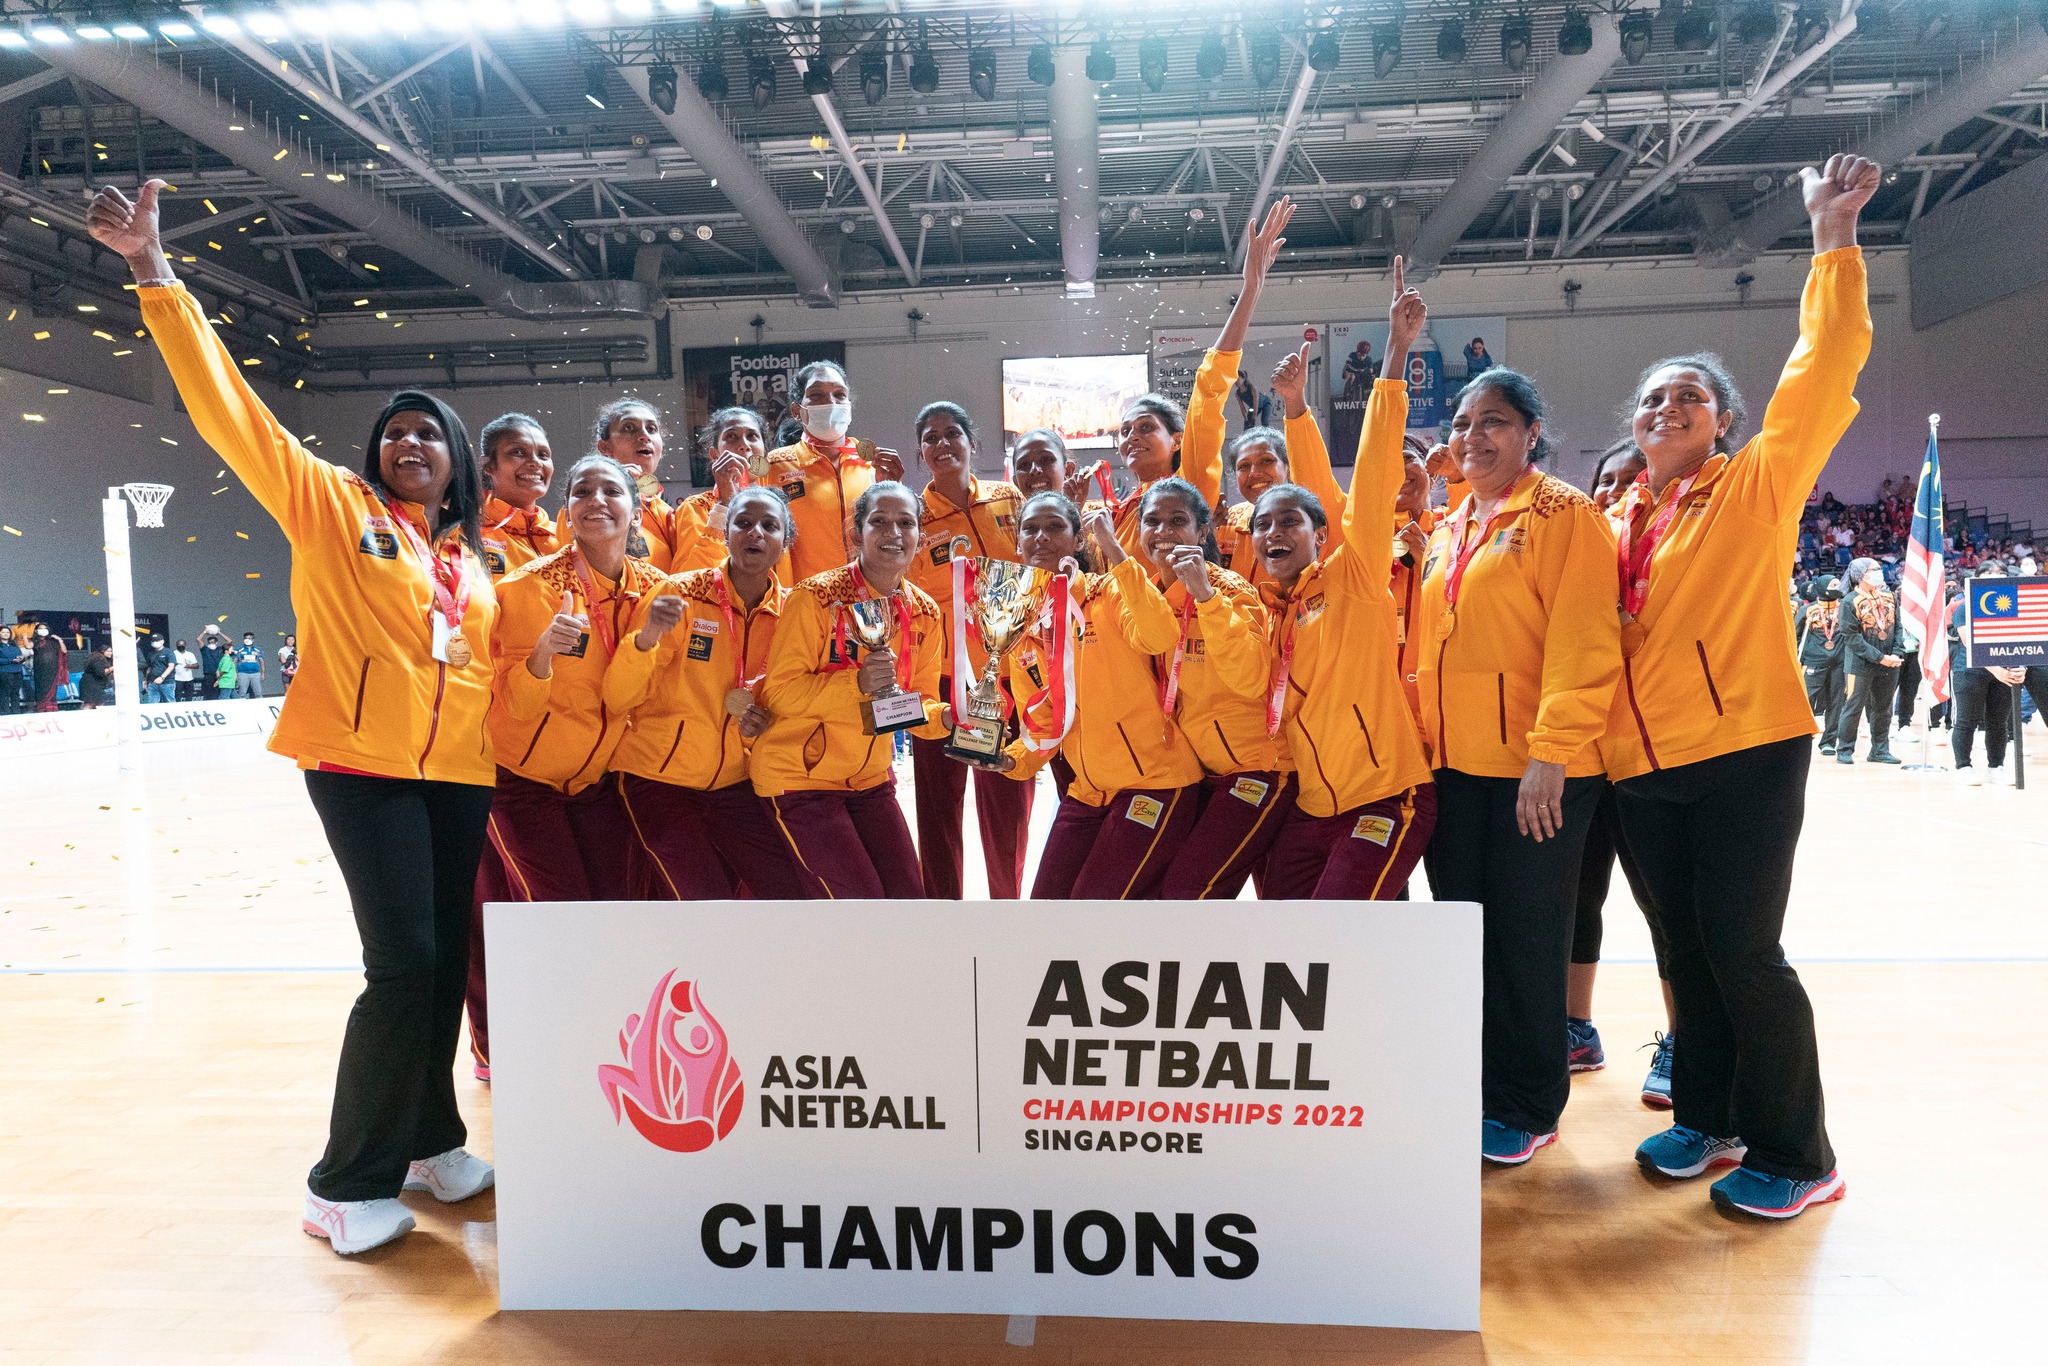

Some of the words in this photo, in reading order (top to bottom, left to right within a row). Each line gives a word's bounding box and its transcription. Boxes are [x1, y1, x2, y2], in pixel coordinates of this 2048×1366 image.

[730, 353, 800, 371] Football
[729, 370, 768, 395] for
[771, 368, 800, 392] al
[1159, 379, 1195, 389] strengt
[1409, 357, 1426, 392] 100
[1170, 391, 1192, 400] toug
[1334, 400, 1360, 409] WHAT
[1408, 397, 1434, 407] CTIVE
[693, 620, 718, 633] Dialog
[1989, 645, 2045, 657] MALAYSIA
[140, 710, 227, 731] Deloitte
[885, 711, 913, 720] CHAMPION
[958, 735, 978, 743] CHALLENGE
[1026, 960, 1330, 1031] ASIAN
[760, 1054, 868, 1090] ASIA
[1023, 1038, 1330, 1091] NETBALL
[760, 1095, 946, 1130] NETBALL
[1023, 1098, 1283, 1126] CHAMPIONSHIPS
[1293, 1103, 1365, 1128] 2022
[1024, 1128, 1203, 1154] SINGAPORE
[700, 1202, 1260, 1281] CHAMPIONS
